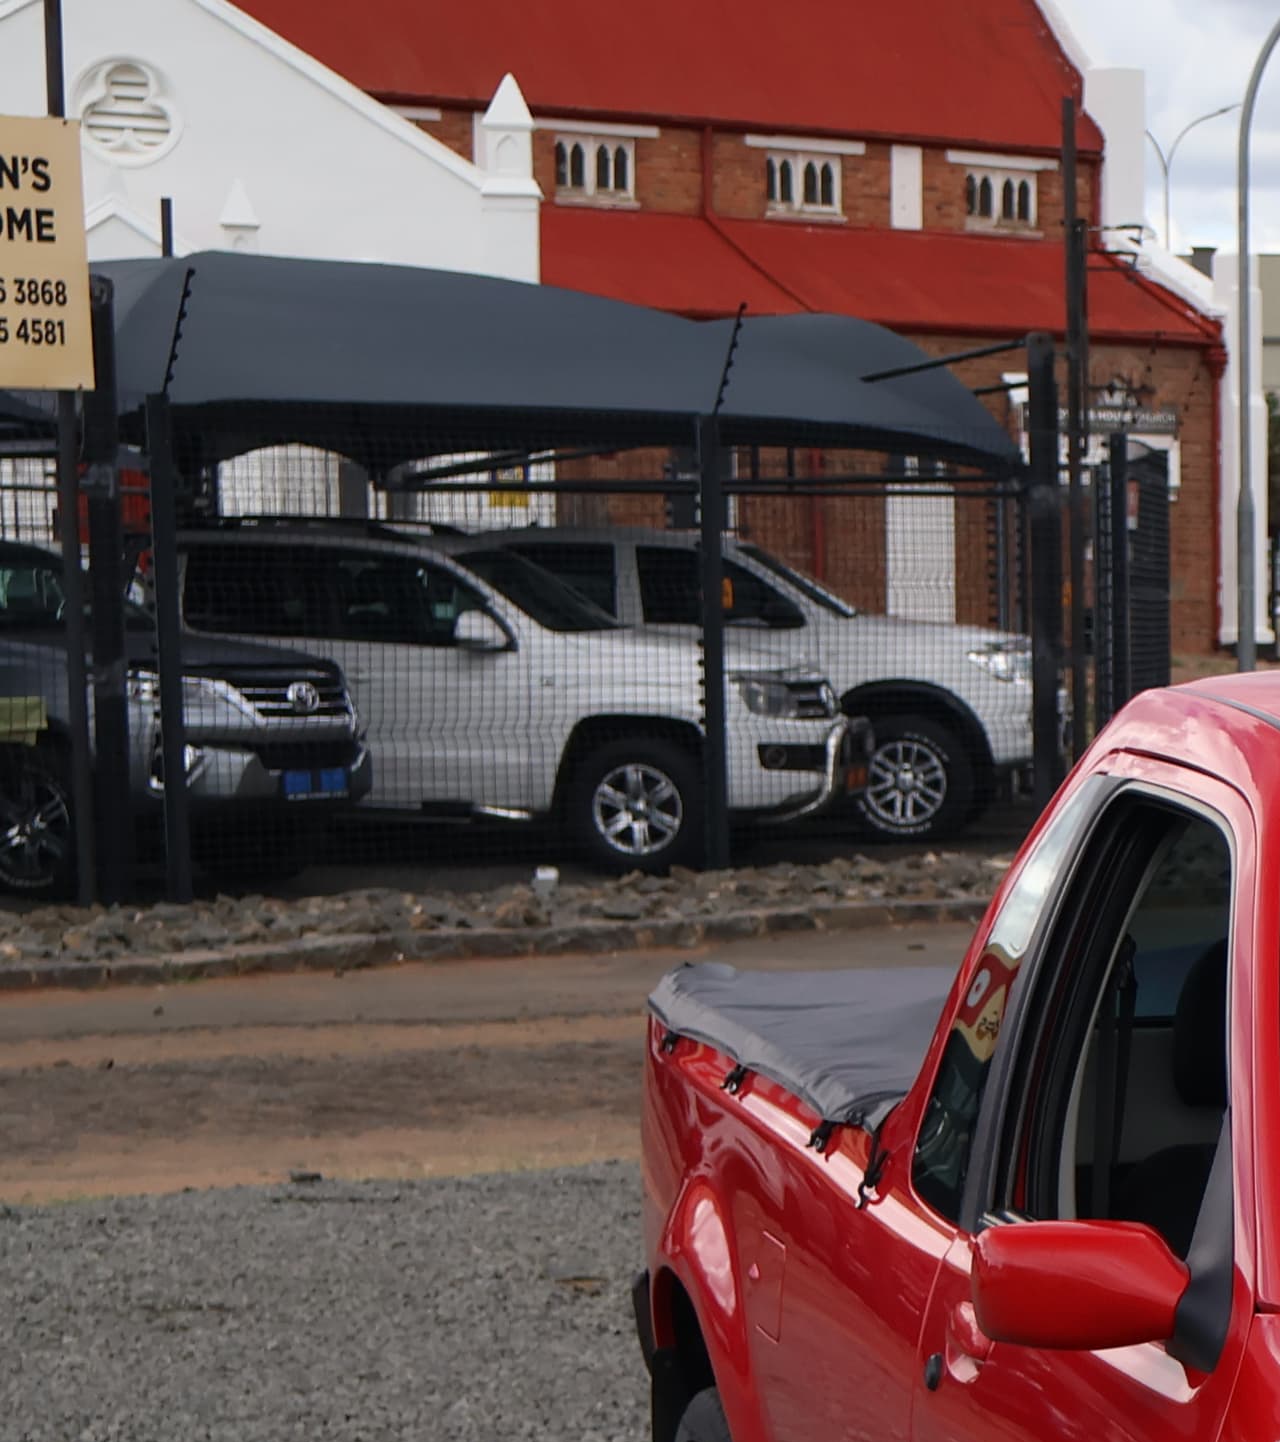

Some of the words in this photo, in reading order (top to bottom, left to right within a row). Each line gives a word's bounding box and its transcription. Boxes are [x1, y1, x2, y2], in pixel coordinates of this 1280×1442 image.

[0, 206, 56, 243] ME
[14, 278, 67, 306] 3868
[16, 317, 65, 347] 4581
